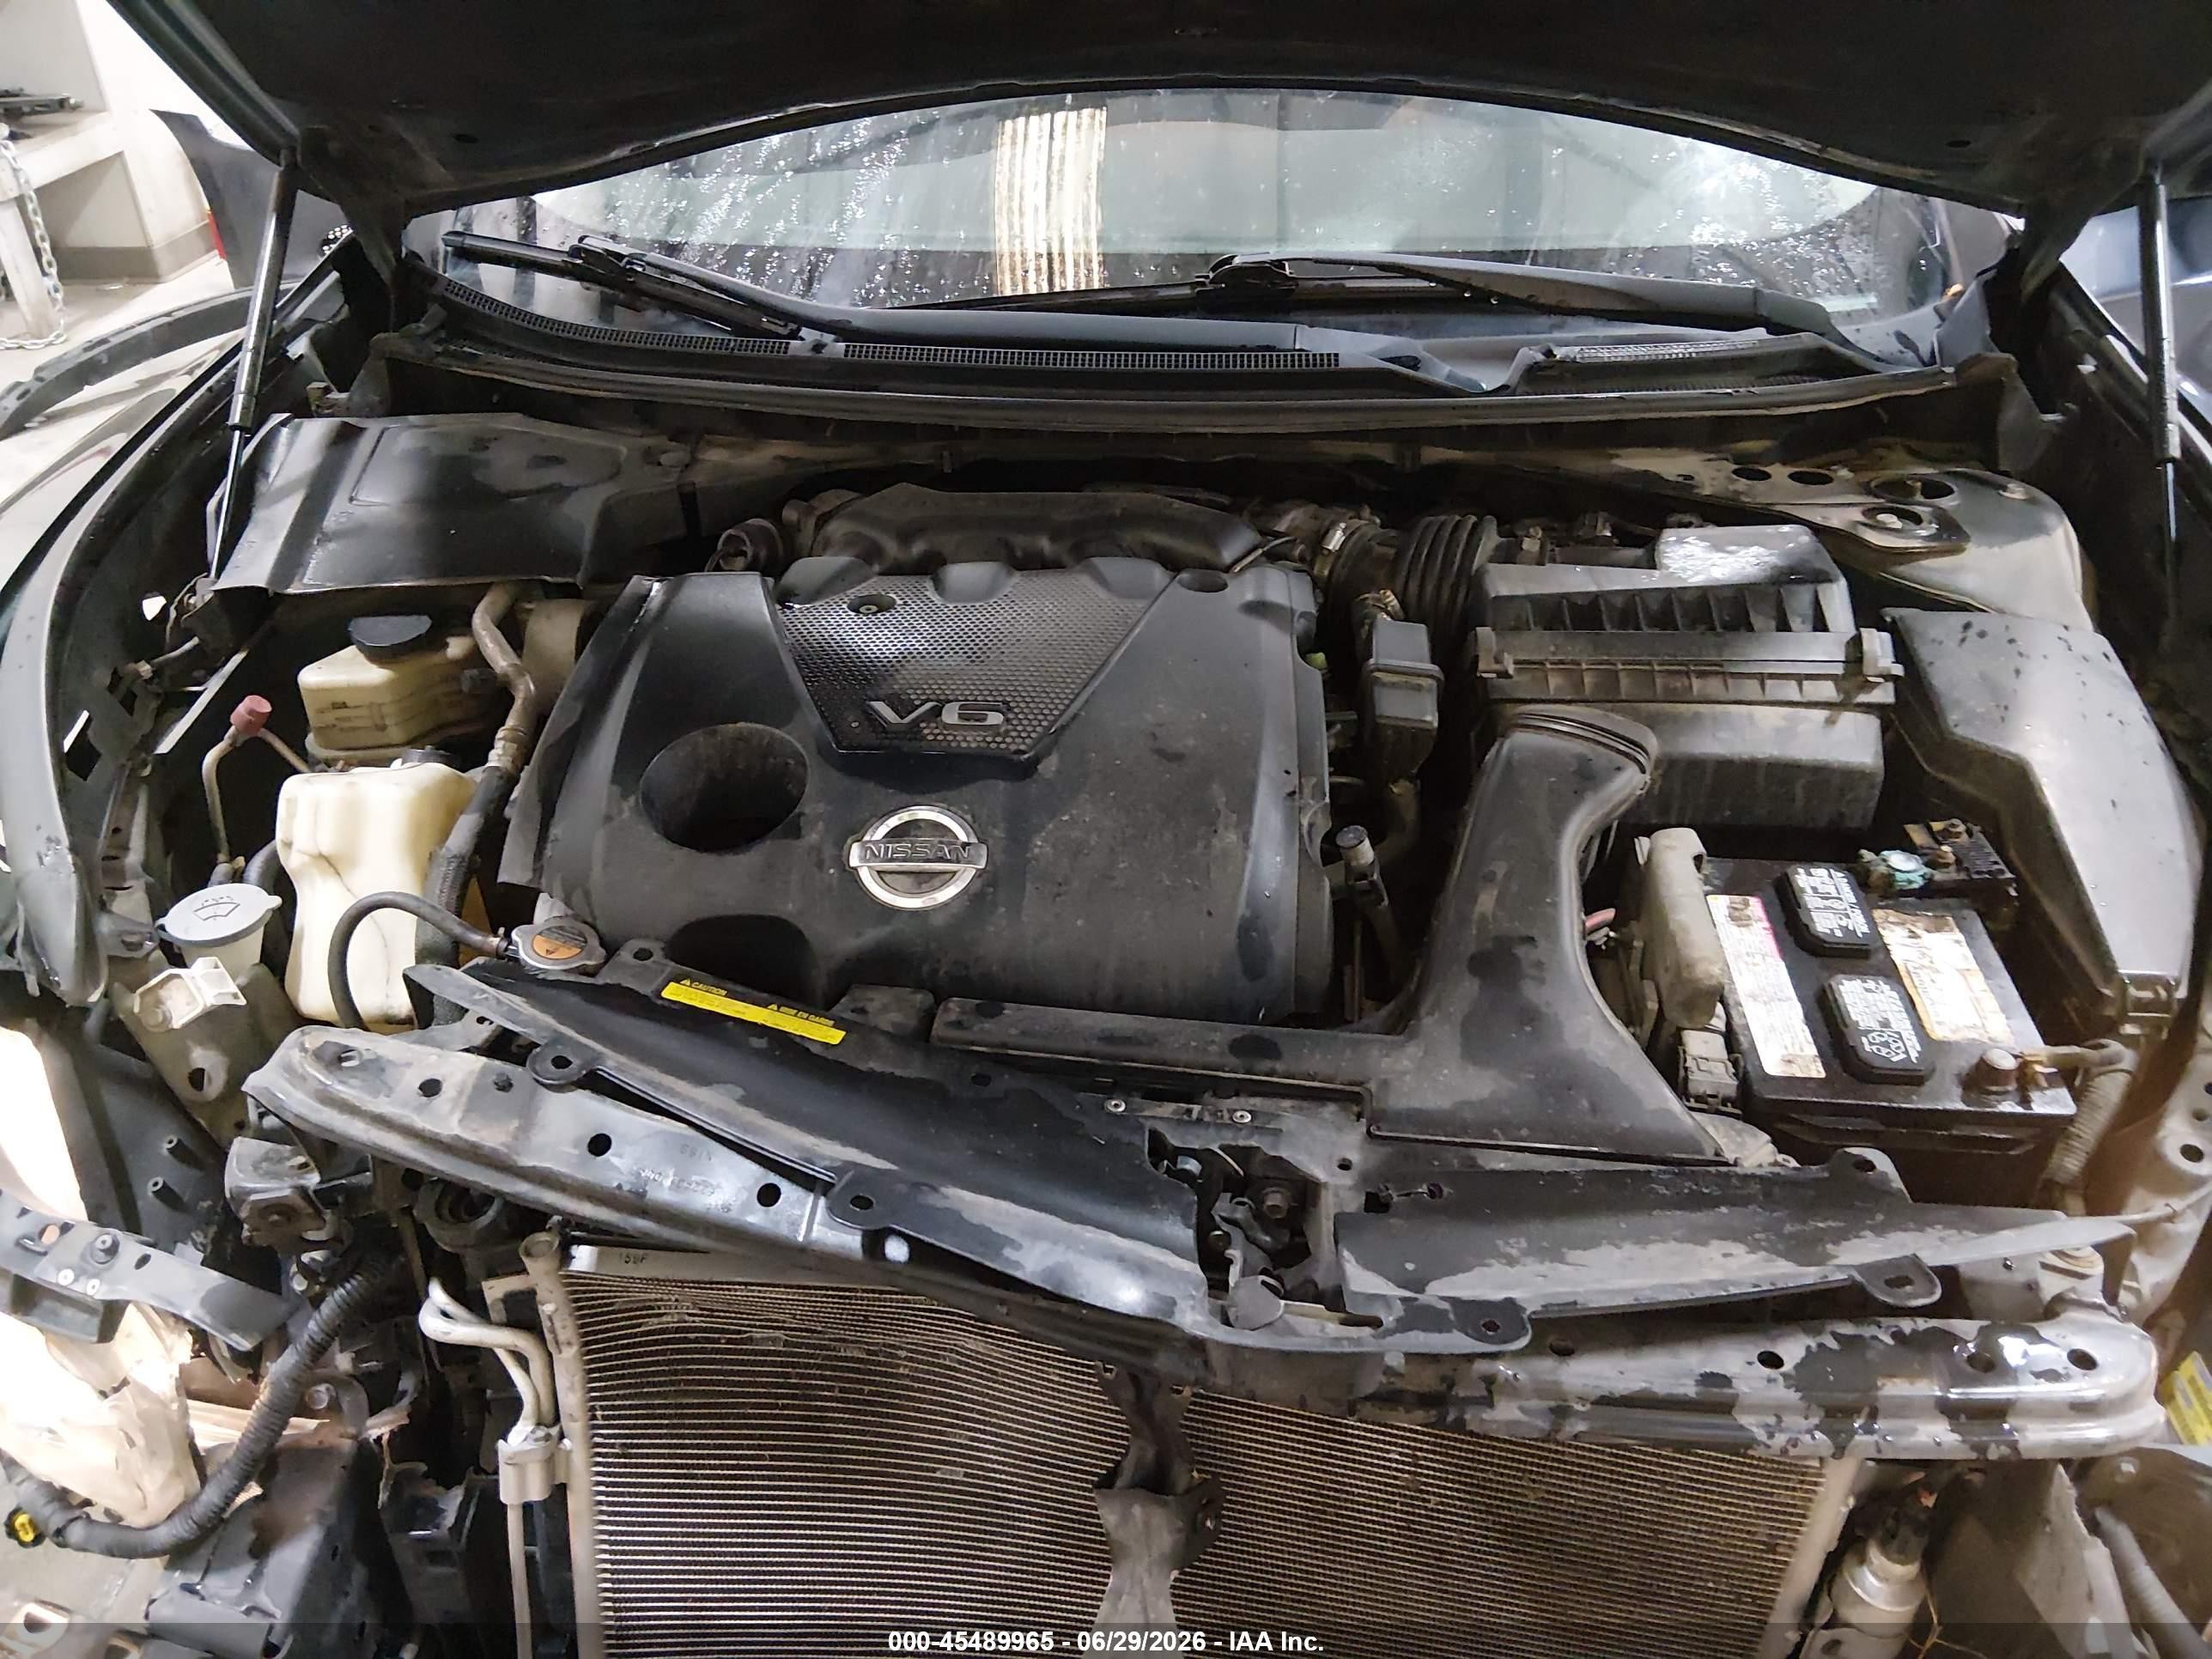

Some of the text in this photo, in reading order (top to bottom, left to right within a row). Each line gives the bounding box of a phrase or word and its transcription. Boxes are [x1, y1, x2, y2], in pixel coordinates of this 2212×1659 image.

[866, 701, 1004, 726] V6
[864, 843, 971, 860] NISSAN
[691, 981, 727, 996] CAUTION
